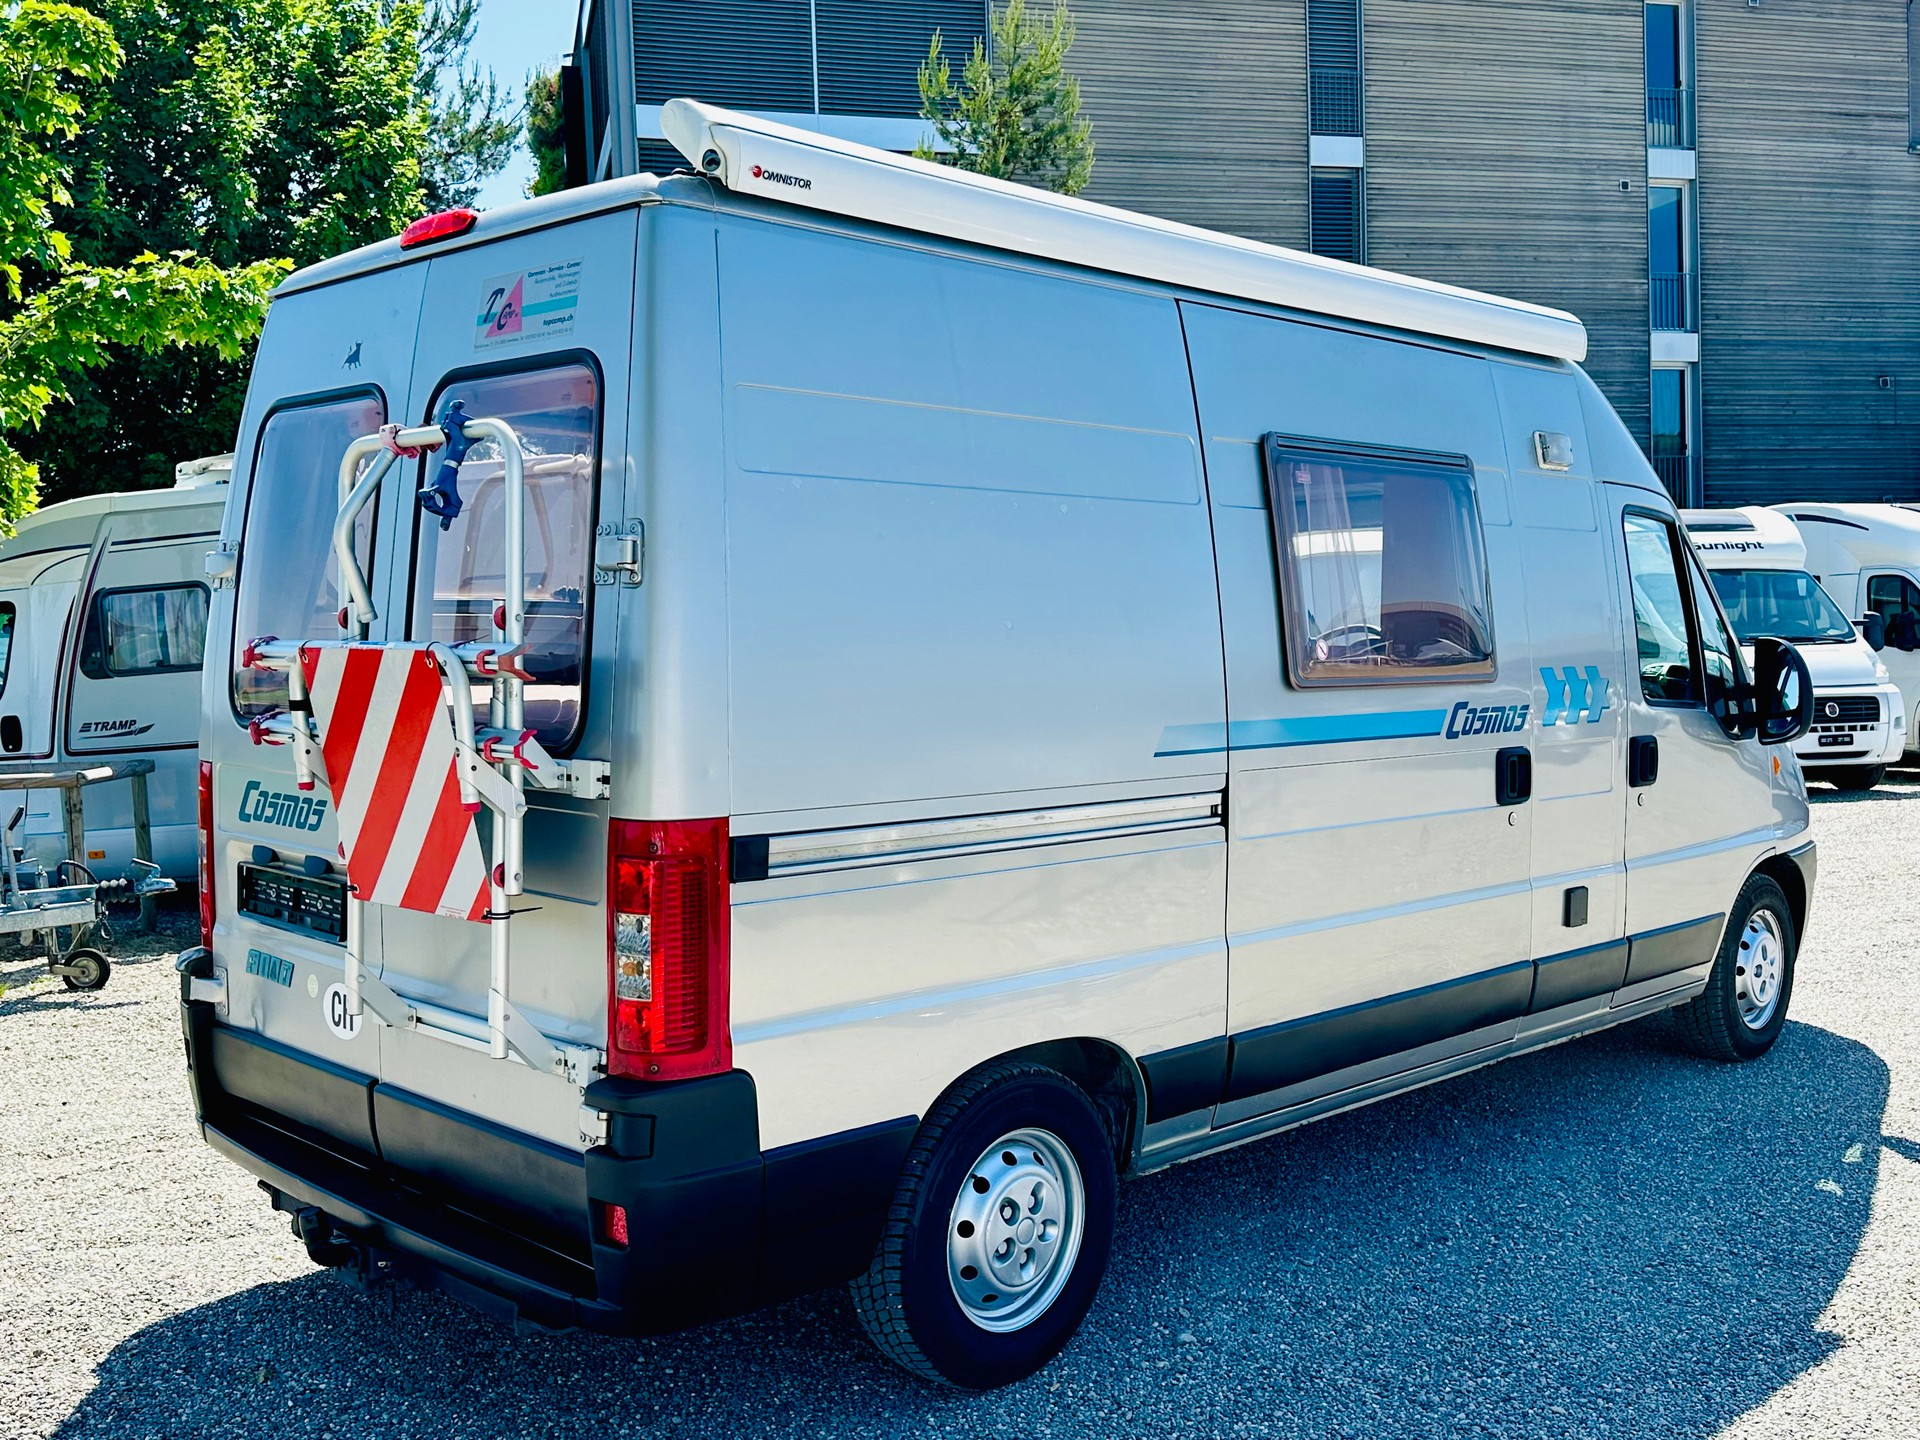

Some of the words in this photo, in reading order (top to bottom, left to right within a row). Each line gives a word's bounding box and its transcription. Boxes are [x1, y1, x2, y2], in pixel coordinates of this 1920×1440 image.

[762, 170, 812, 190] OMNISTOR
[543, 314, 574, 327] topcamp.ch
[1692, 541, 1765, 552] Sunlight
[1445, 701, 1530, 740] Cosmos
[238, 780, 328, 832] Cosmos
[246, 949, 294, 988] FIAT
